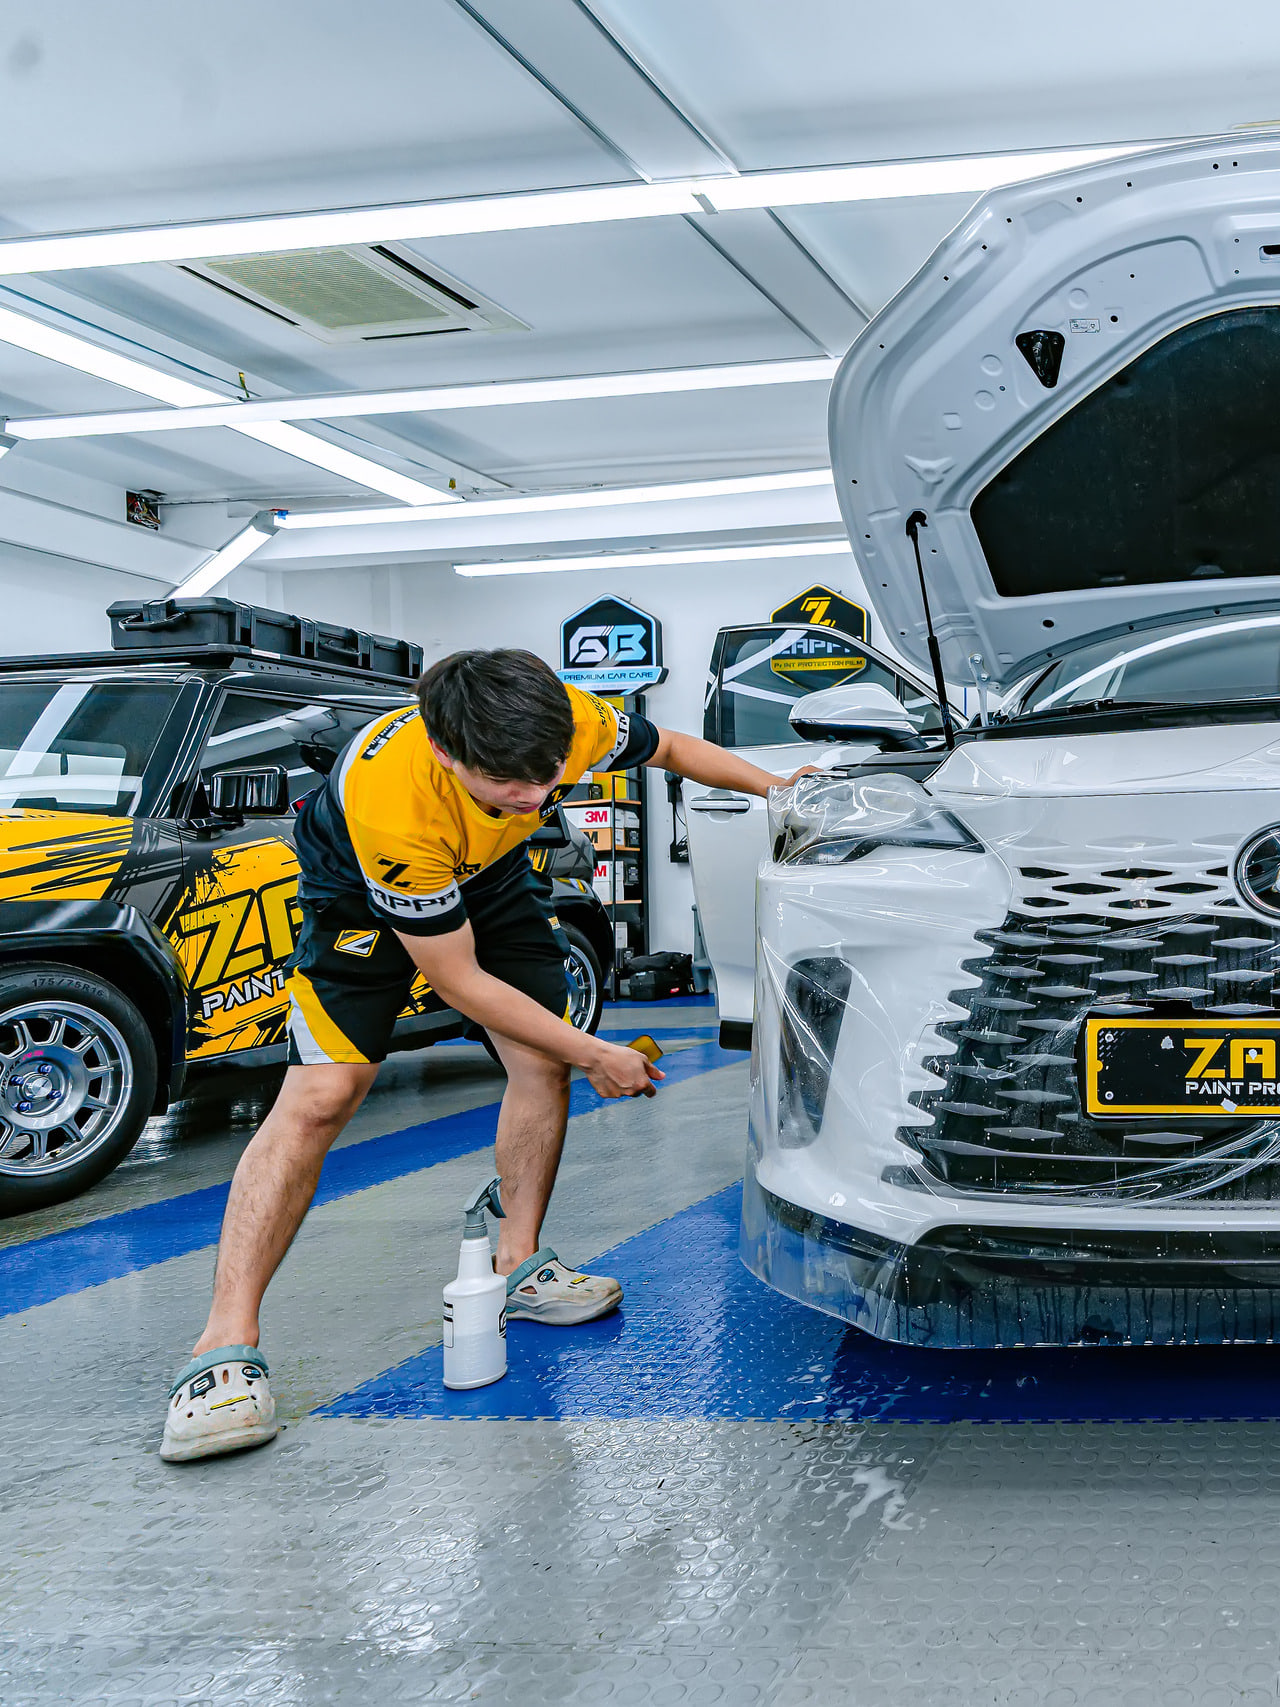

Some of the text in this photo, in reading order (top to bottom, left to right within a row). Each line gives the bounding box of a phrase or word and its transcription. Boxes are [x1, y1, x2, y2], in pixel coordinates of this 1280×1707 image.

[564, 673, 605, 681] PREMIUM
[585, 810, 608, 823] 3M
[584, 831, 599, 844] M
[594, 865, 607, 877] M
[368, 880, 458, 912] APPA
[202, 969, 285, 1018] PAINT
[1185, 1081, 1244, 1096] PAINT
